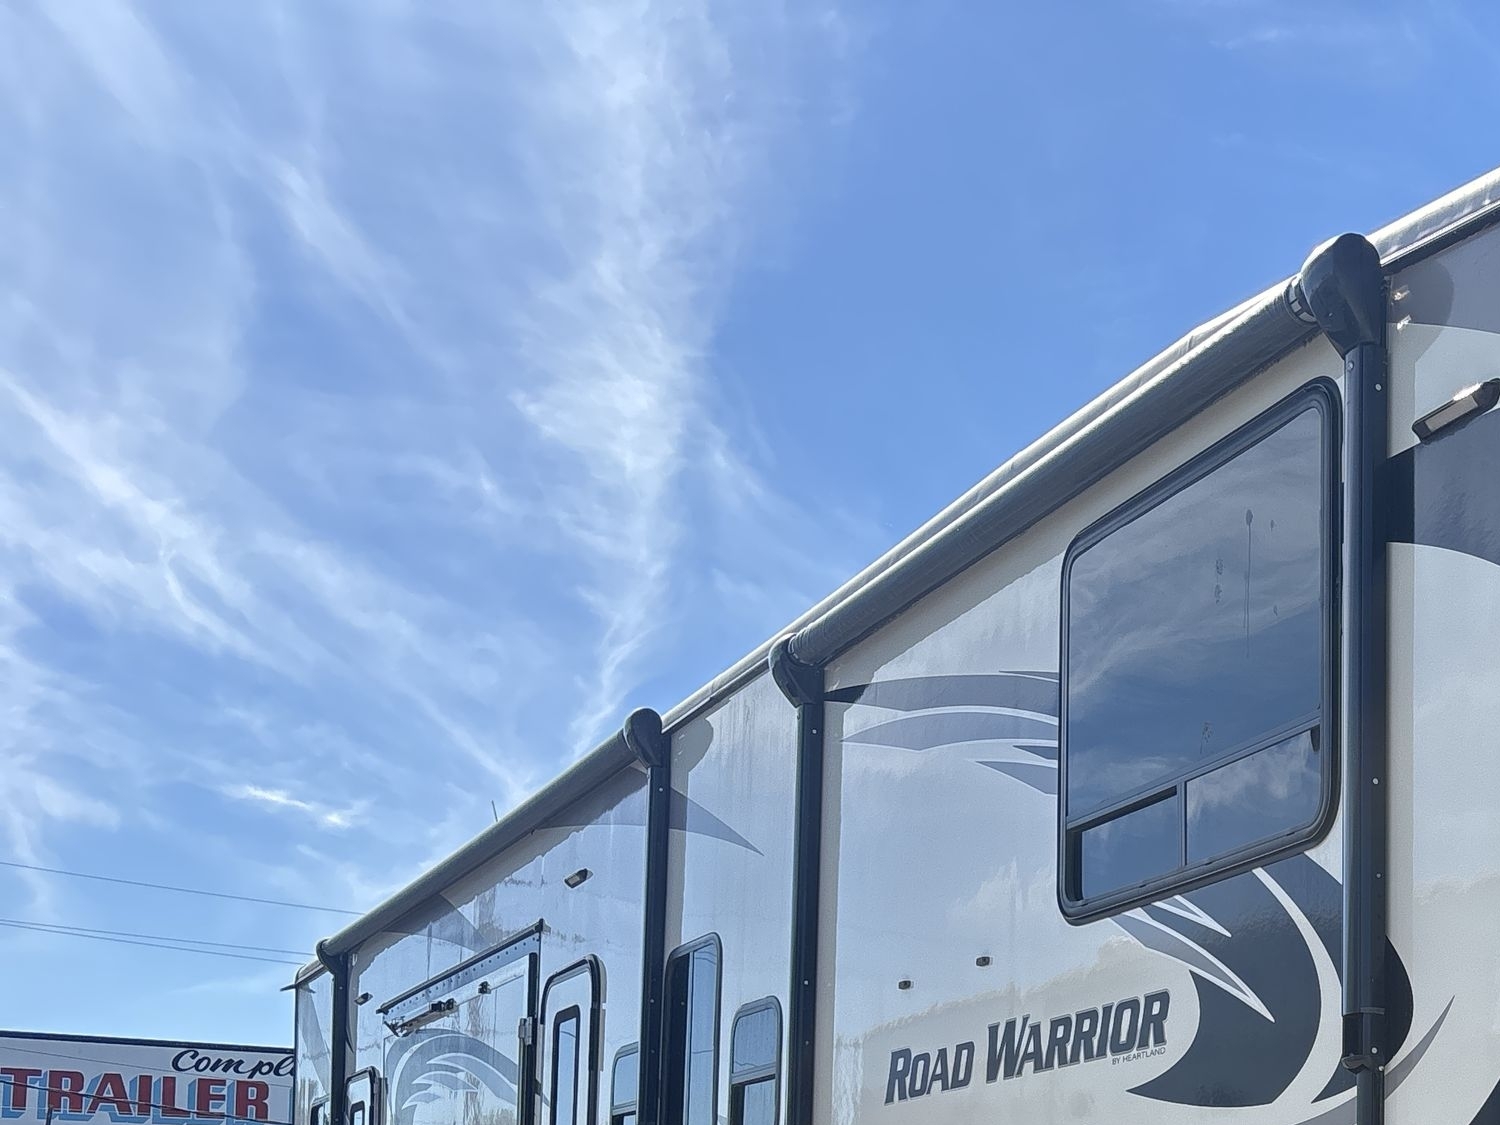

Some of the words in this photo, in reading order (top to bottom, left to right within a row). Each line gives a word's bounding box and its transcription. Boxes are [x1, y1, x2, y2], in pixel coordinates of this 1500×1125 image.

[171, 1049, 294, 1079] Compl
[884, 1040, 976, 1106] ROAD
[985, 988, 1171, 1085] WARRIOR
[1111, 1057, 1121, 1065] BY
[1122, 1046, 1167, 1063] HEARTLAND
[0, 1067, 269, 1121] TRAILER
